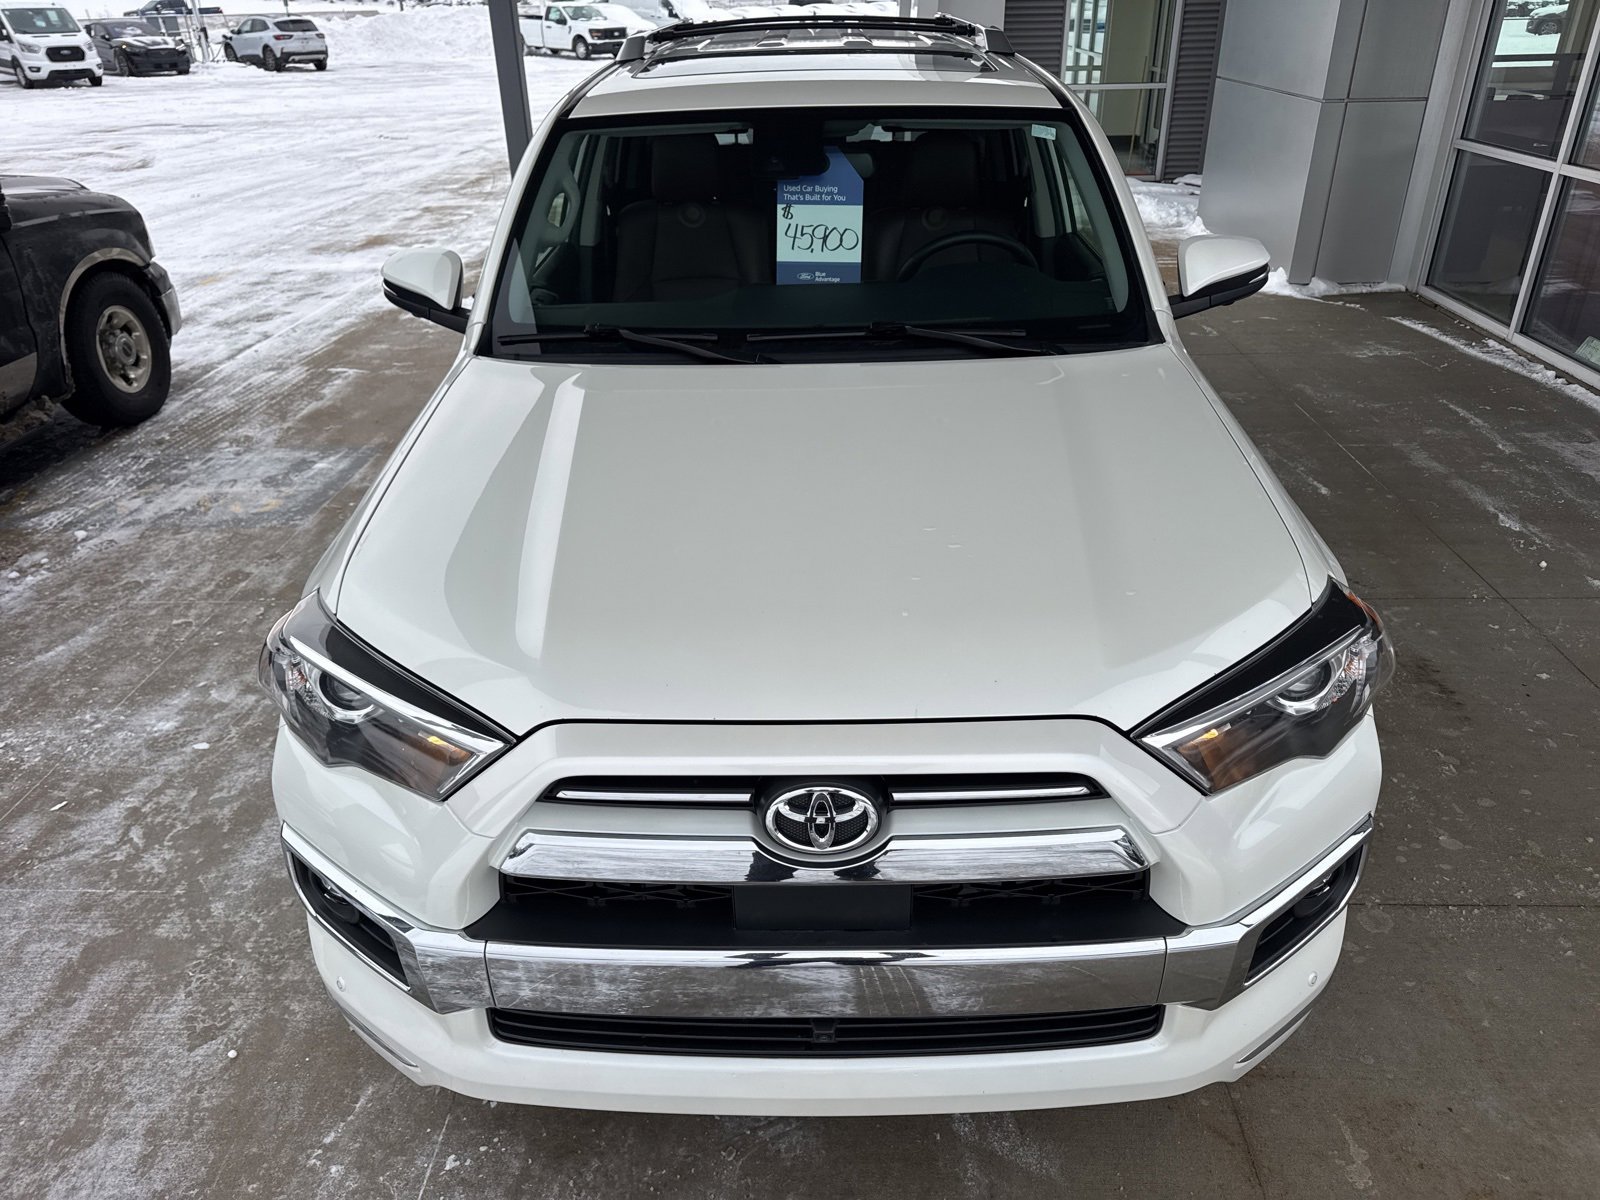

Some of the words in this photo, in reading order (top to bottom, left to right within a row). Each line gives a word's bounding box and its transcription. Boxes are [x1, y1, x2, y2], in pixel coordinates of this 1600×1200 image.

[783, 184, 801, 192] Used
[802, 184, 814, 192] Car
[815, 184, 838, 194] Buying
[783, 193, 804, 201] That's
[805, 193, 821, 201] Built
[822, 193, 832, 201] for
[781, 203, 795, 220] $
